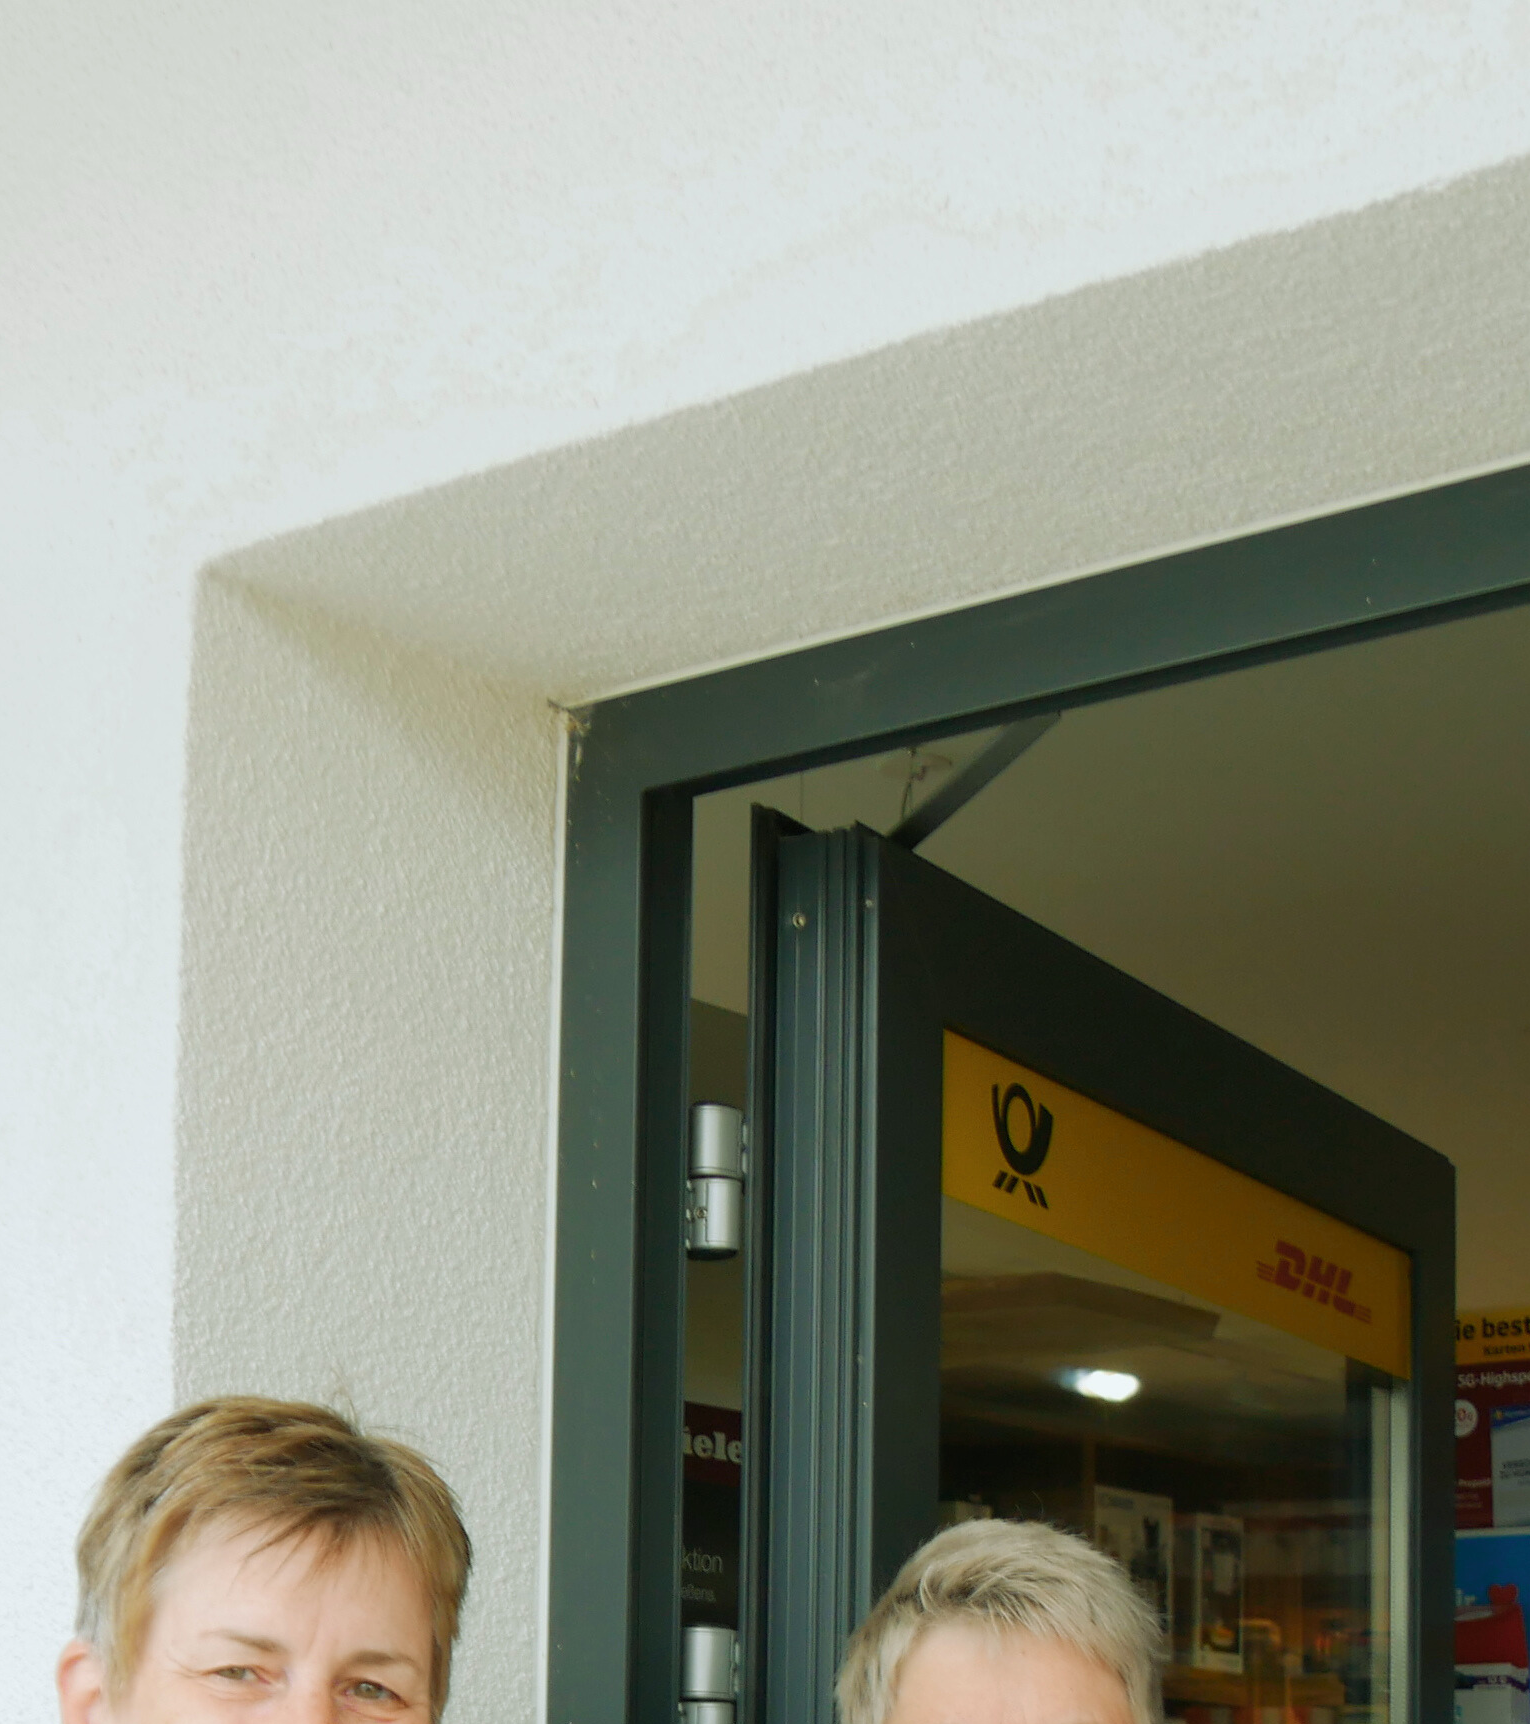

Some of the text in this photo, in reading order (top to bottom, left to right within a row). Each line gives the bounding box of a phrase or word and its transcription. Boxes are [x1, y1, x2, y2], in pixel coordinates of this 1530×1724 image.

[1266, 1240, 1362, 1321] DHL
[1455, 1320, 1475, 1341] ie
[1484, 1343, 1526, 1356] Karten
[683, 1426, 742, 1464] iele
[682, 1546, 724, 1575] ktion
